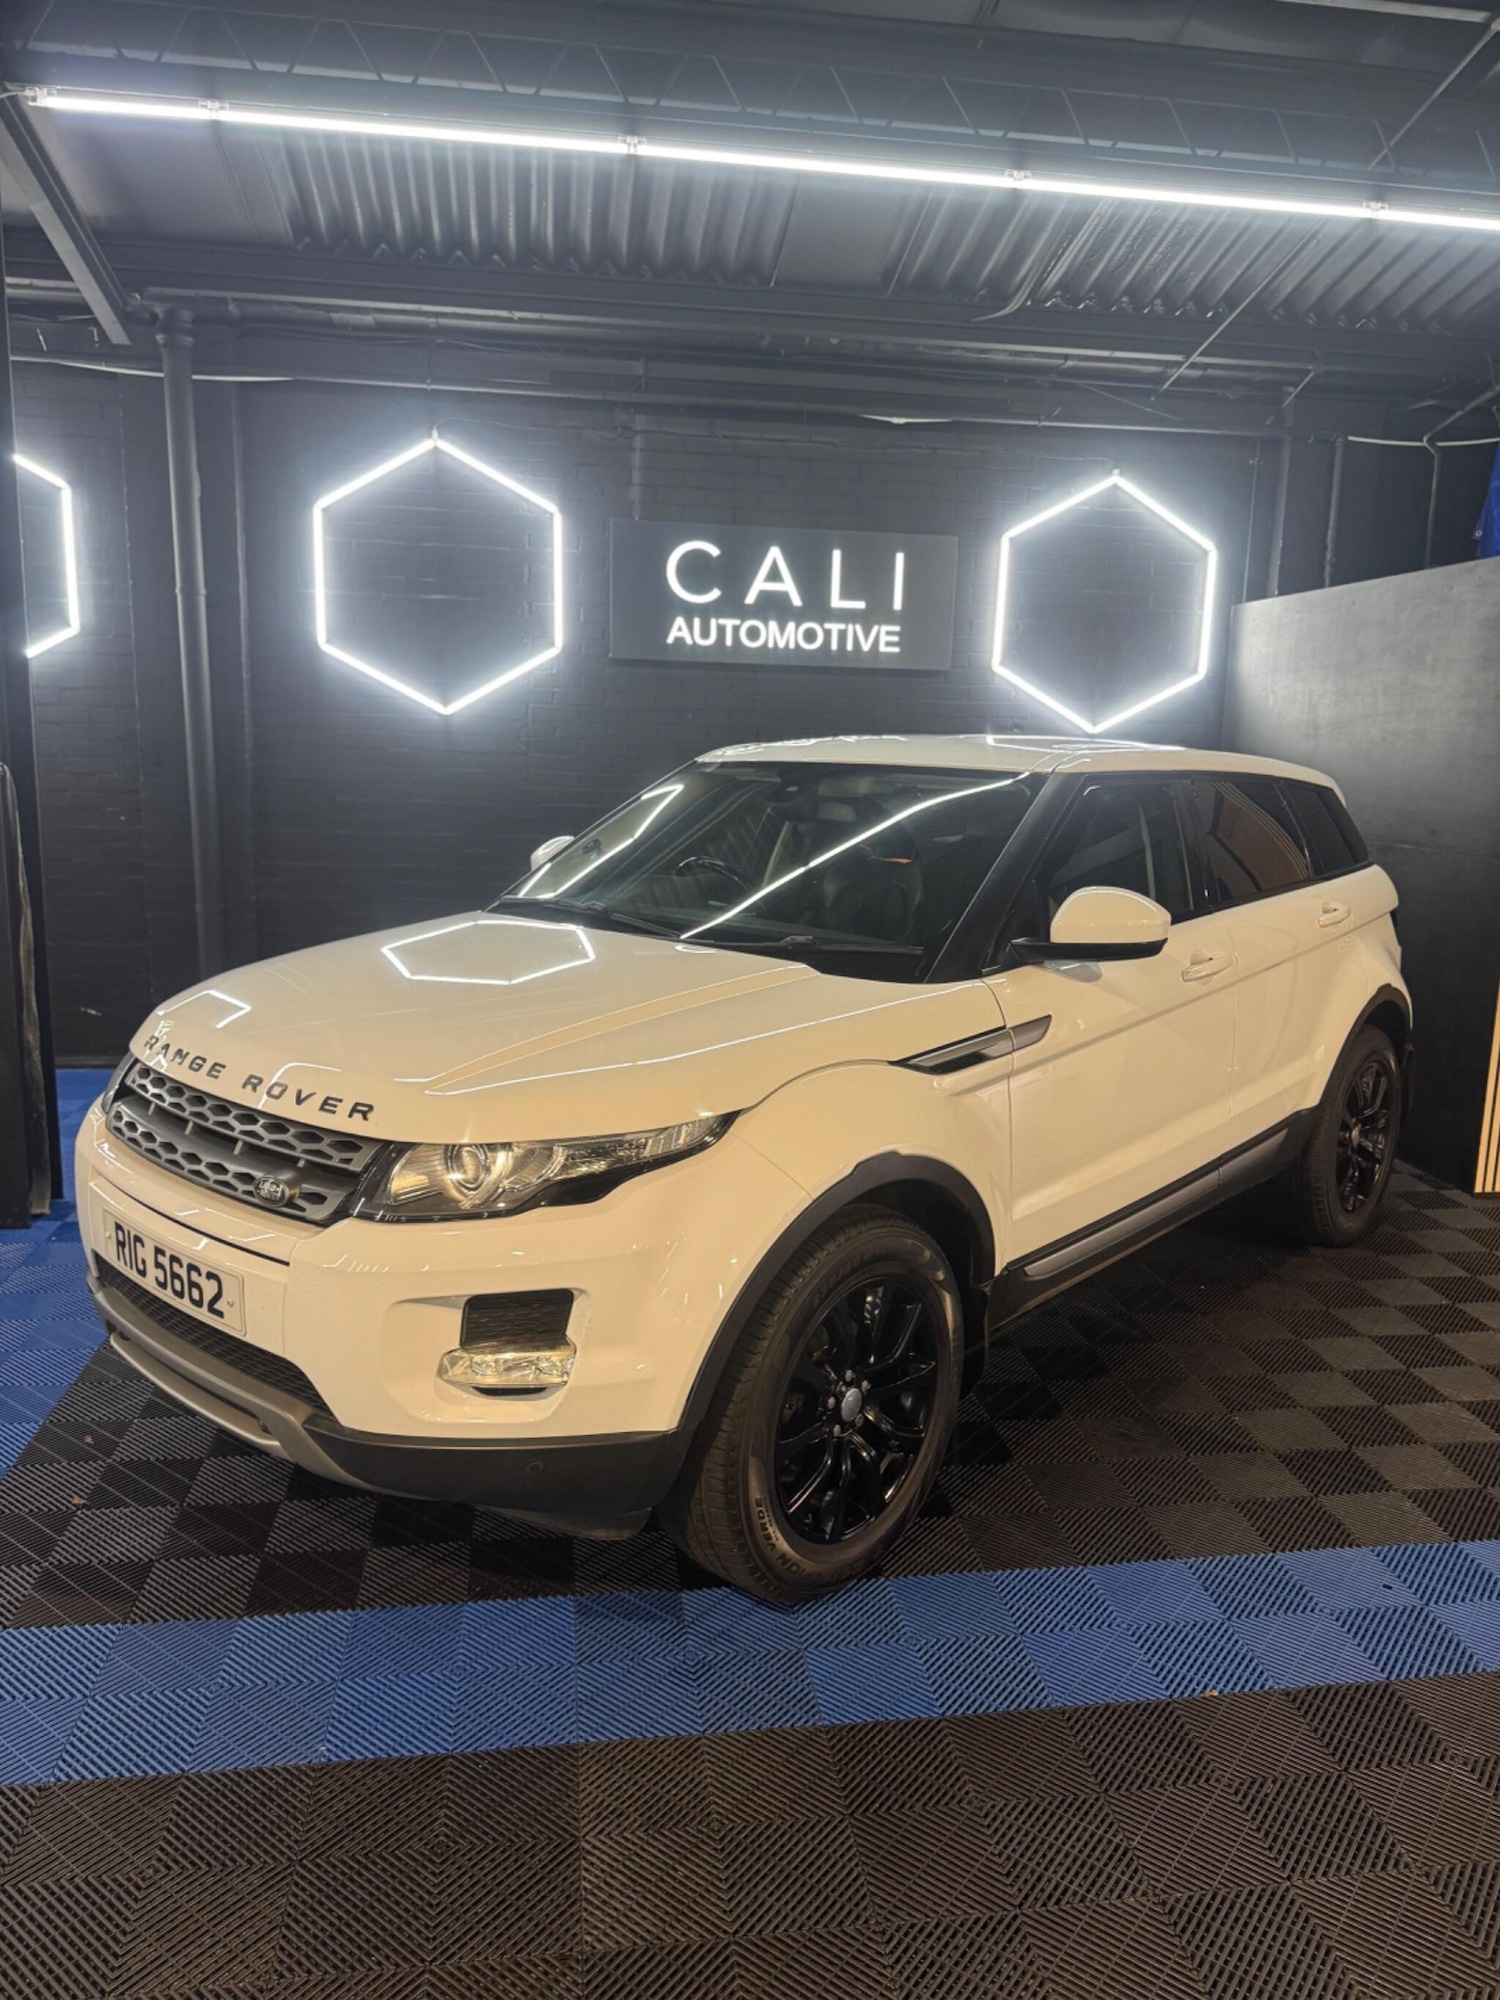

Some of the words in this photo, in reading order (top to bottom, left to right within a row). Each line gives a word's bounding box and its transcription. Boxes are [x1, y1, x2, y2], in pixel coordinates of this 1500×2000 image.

[665, 540, 905, 611] CALI
[666, 616, 901, 653] AUTOMOTIVE
[143, 1035, 227, 1080] RANGE
[241, 1073, 375, 1122] ROVER
[114, 1221, 147, 1279] RIG
[153, 1245, 225, 1320] 5662
